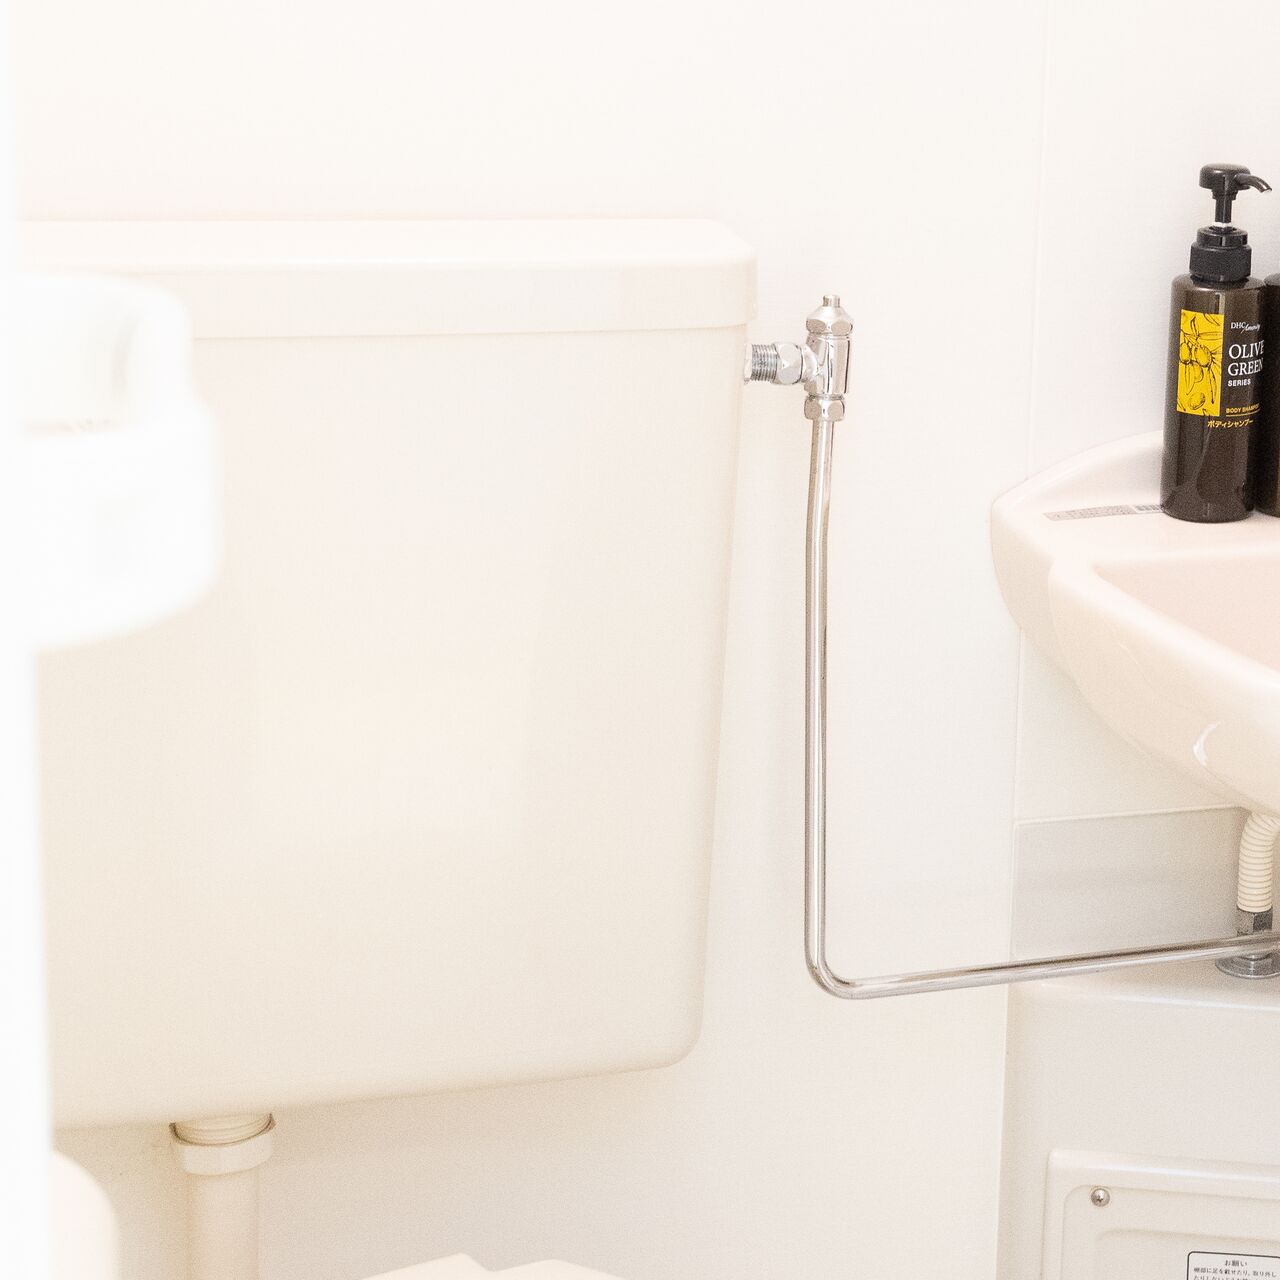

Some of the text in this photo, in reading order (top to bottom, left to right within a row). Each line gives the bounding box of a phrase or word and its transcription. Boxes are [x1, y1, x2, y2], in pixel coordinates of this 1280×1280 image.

[1230, 321, 1246, 329] DHC
[1229, 339, 1265, 359] OLIVE
[1227, 357, 1264, 376] GREEN
[1227, 378, 1251, 387] SERIES
[1207, 418, 1254, 428] ボディシャンプー
[1224, 1259, 1247, 1267] お願い
